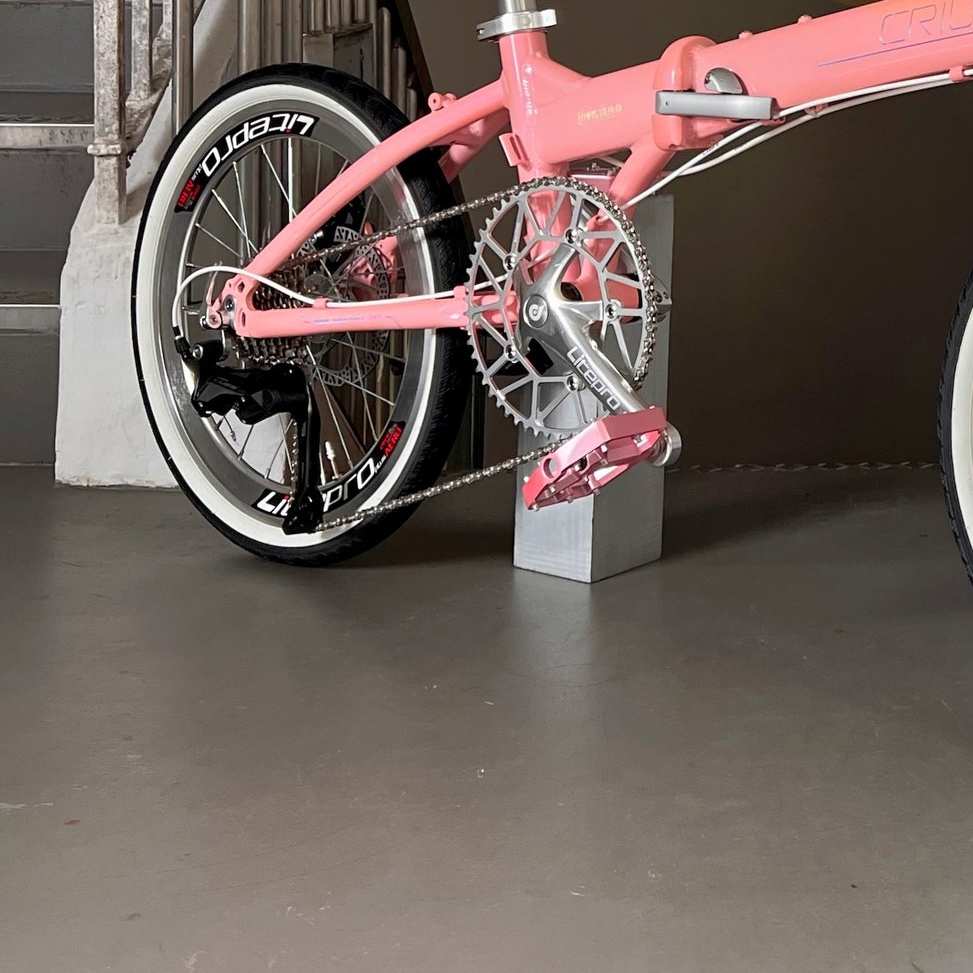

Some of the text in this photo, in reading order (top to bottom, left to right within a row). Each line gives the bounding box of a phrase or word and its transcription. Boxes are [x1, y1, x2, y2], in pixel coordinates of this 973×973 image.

[201, 113, 314, 176] Litepro
[566, 346, 620, 410] Litepro
[257, 457, 374, 516] Lipro
